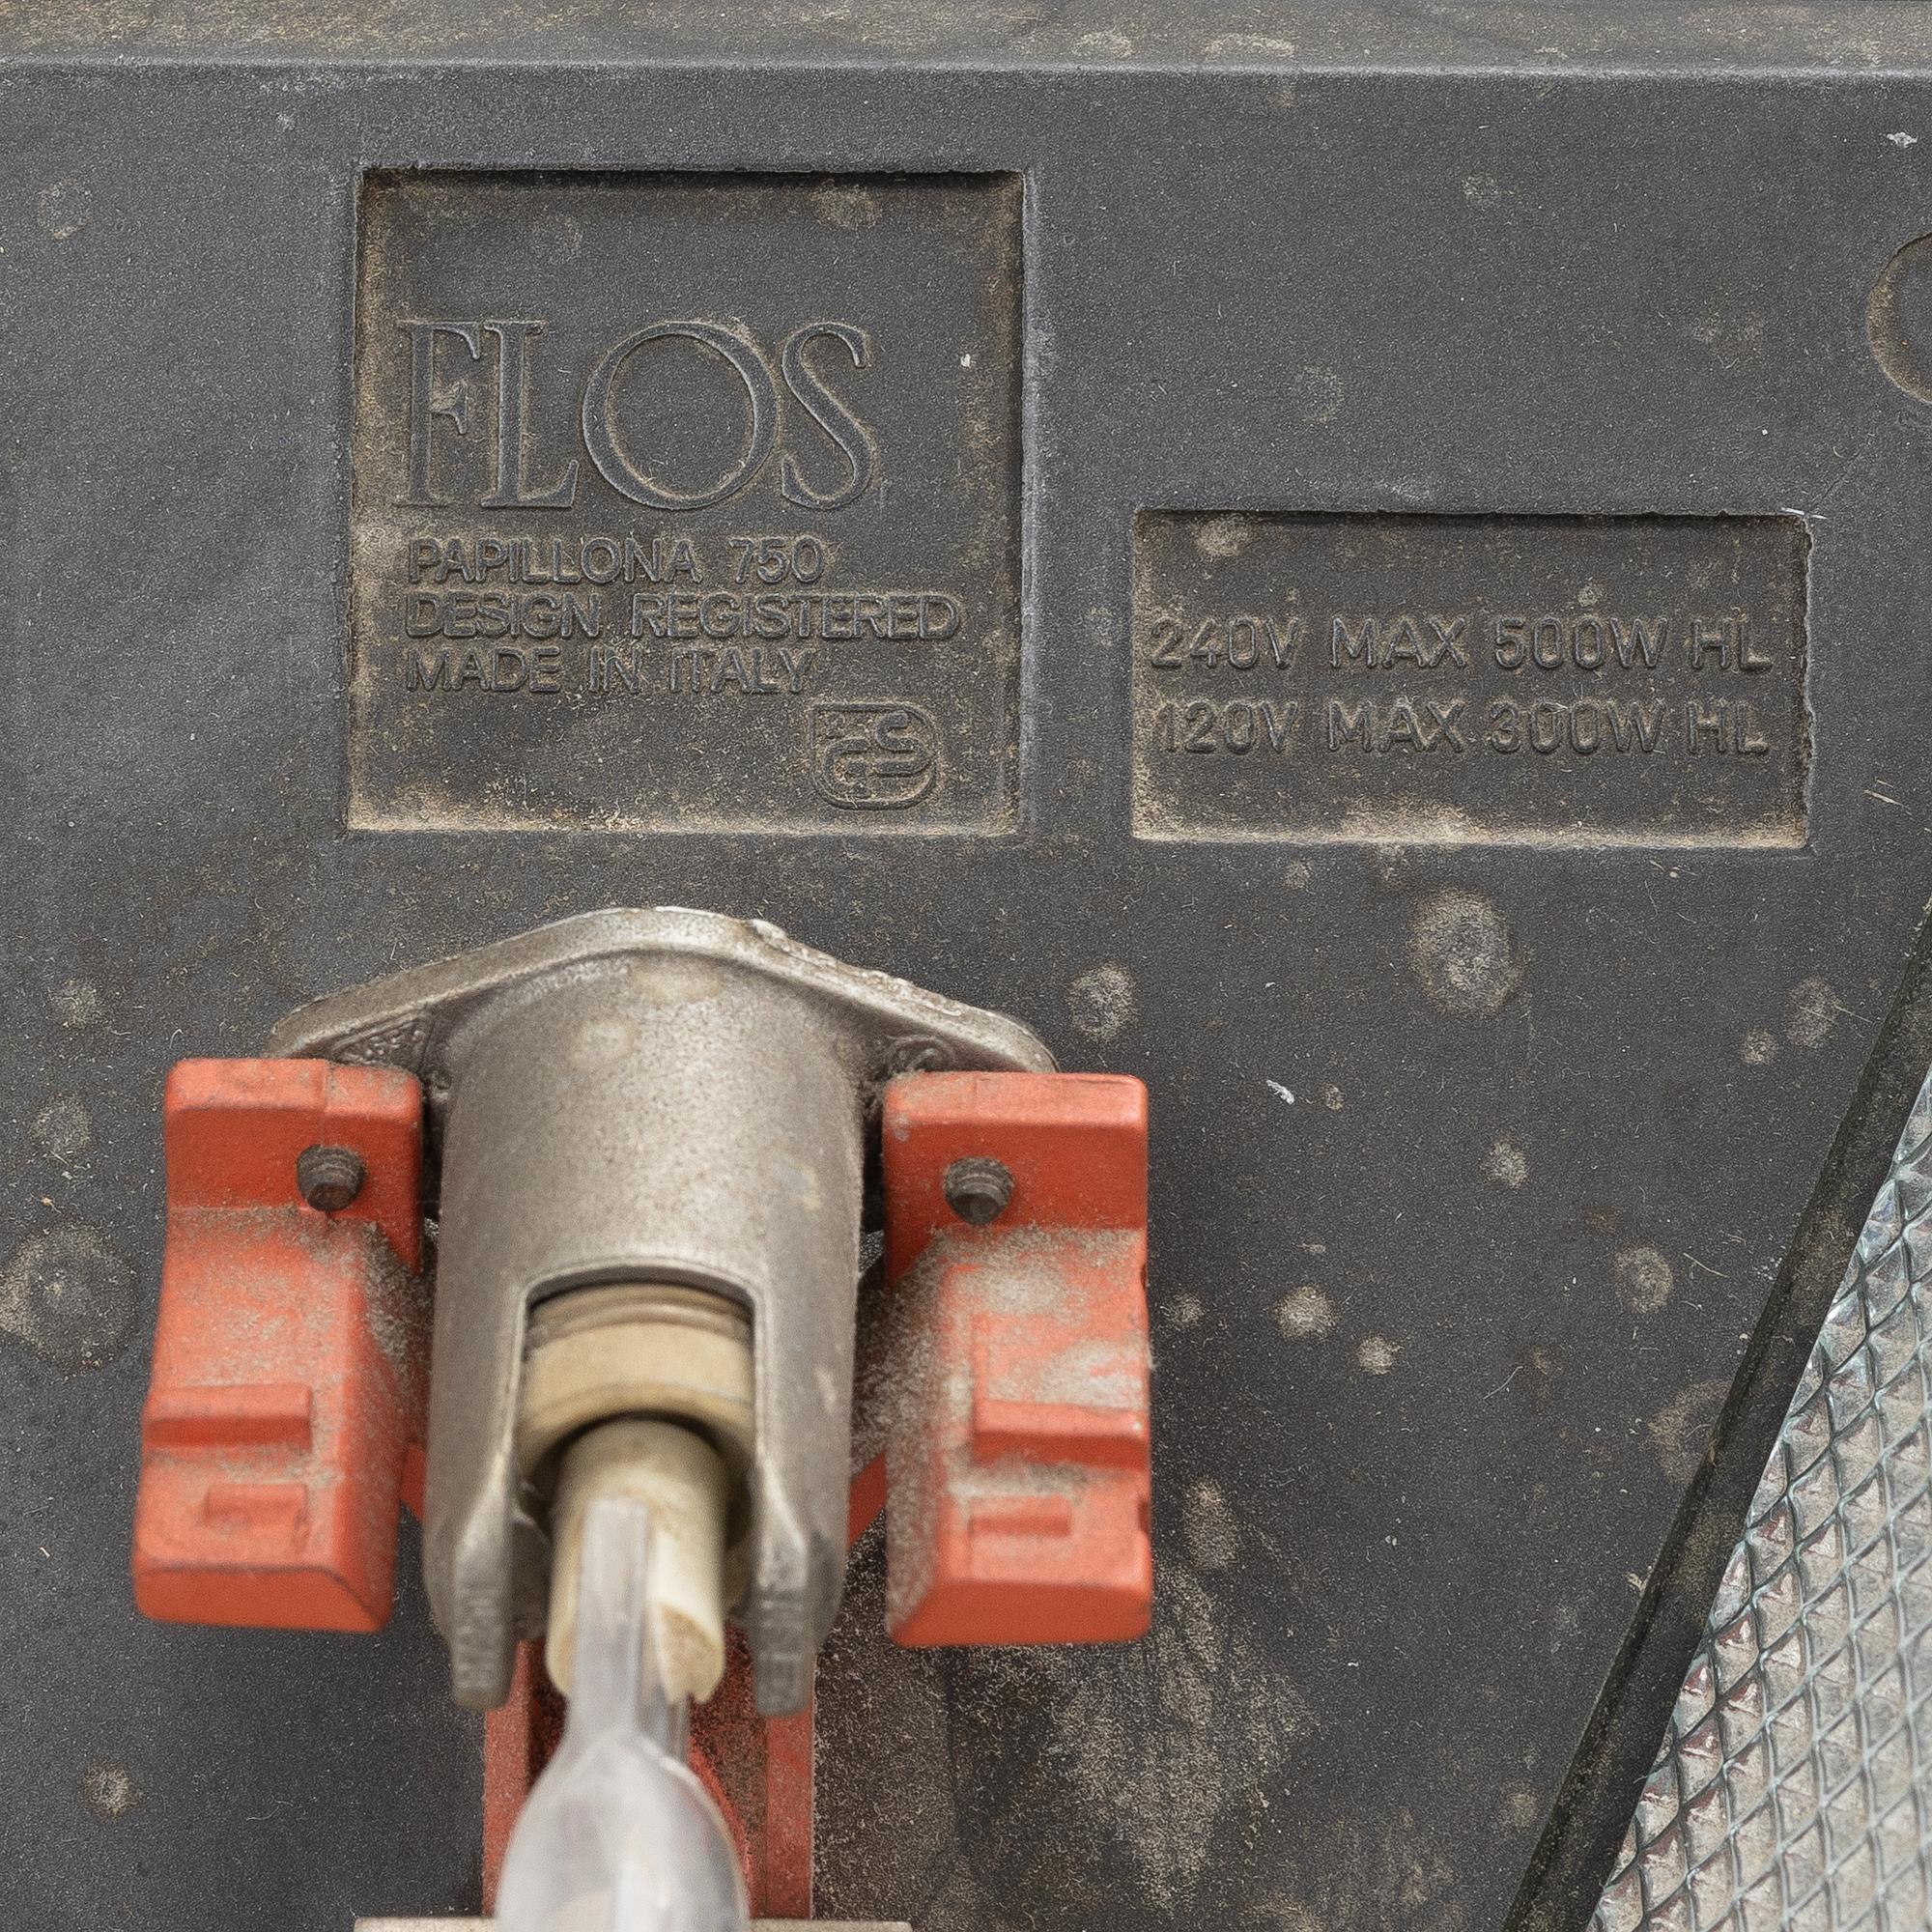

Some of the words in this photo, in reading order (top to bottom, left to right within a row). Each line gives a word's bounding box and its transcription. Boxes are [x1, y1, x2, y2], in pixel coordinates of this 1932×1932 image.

[394, 320, 873, 509] FLOS
[410, 536, 703, 582] PAPILLONA
[728, 536, 823, 582] 750
[406, 591, 601, 638] DESIGN
[631, 591, 960, 639] REGISTERED
[1151, 616, 1301, 668] 240V
[1330, 616, 1468, 668] MAX
[1495, 616, 1668, 668] 500W
[1691, 617, 1772, 670] HL
[407, 645, 561, 692] MADE
[589, 645, 641, 693] IN
[669, 646, 813, 694] ITALY
[1158, 699, 1298, 753] 120V
[1329, 699, 1465, 753] MAX
[1491, 699, 1666, 753] 300W
[1687, 700, 1769, 753] HL
